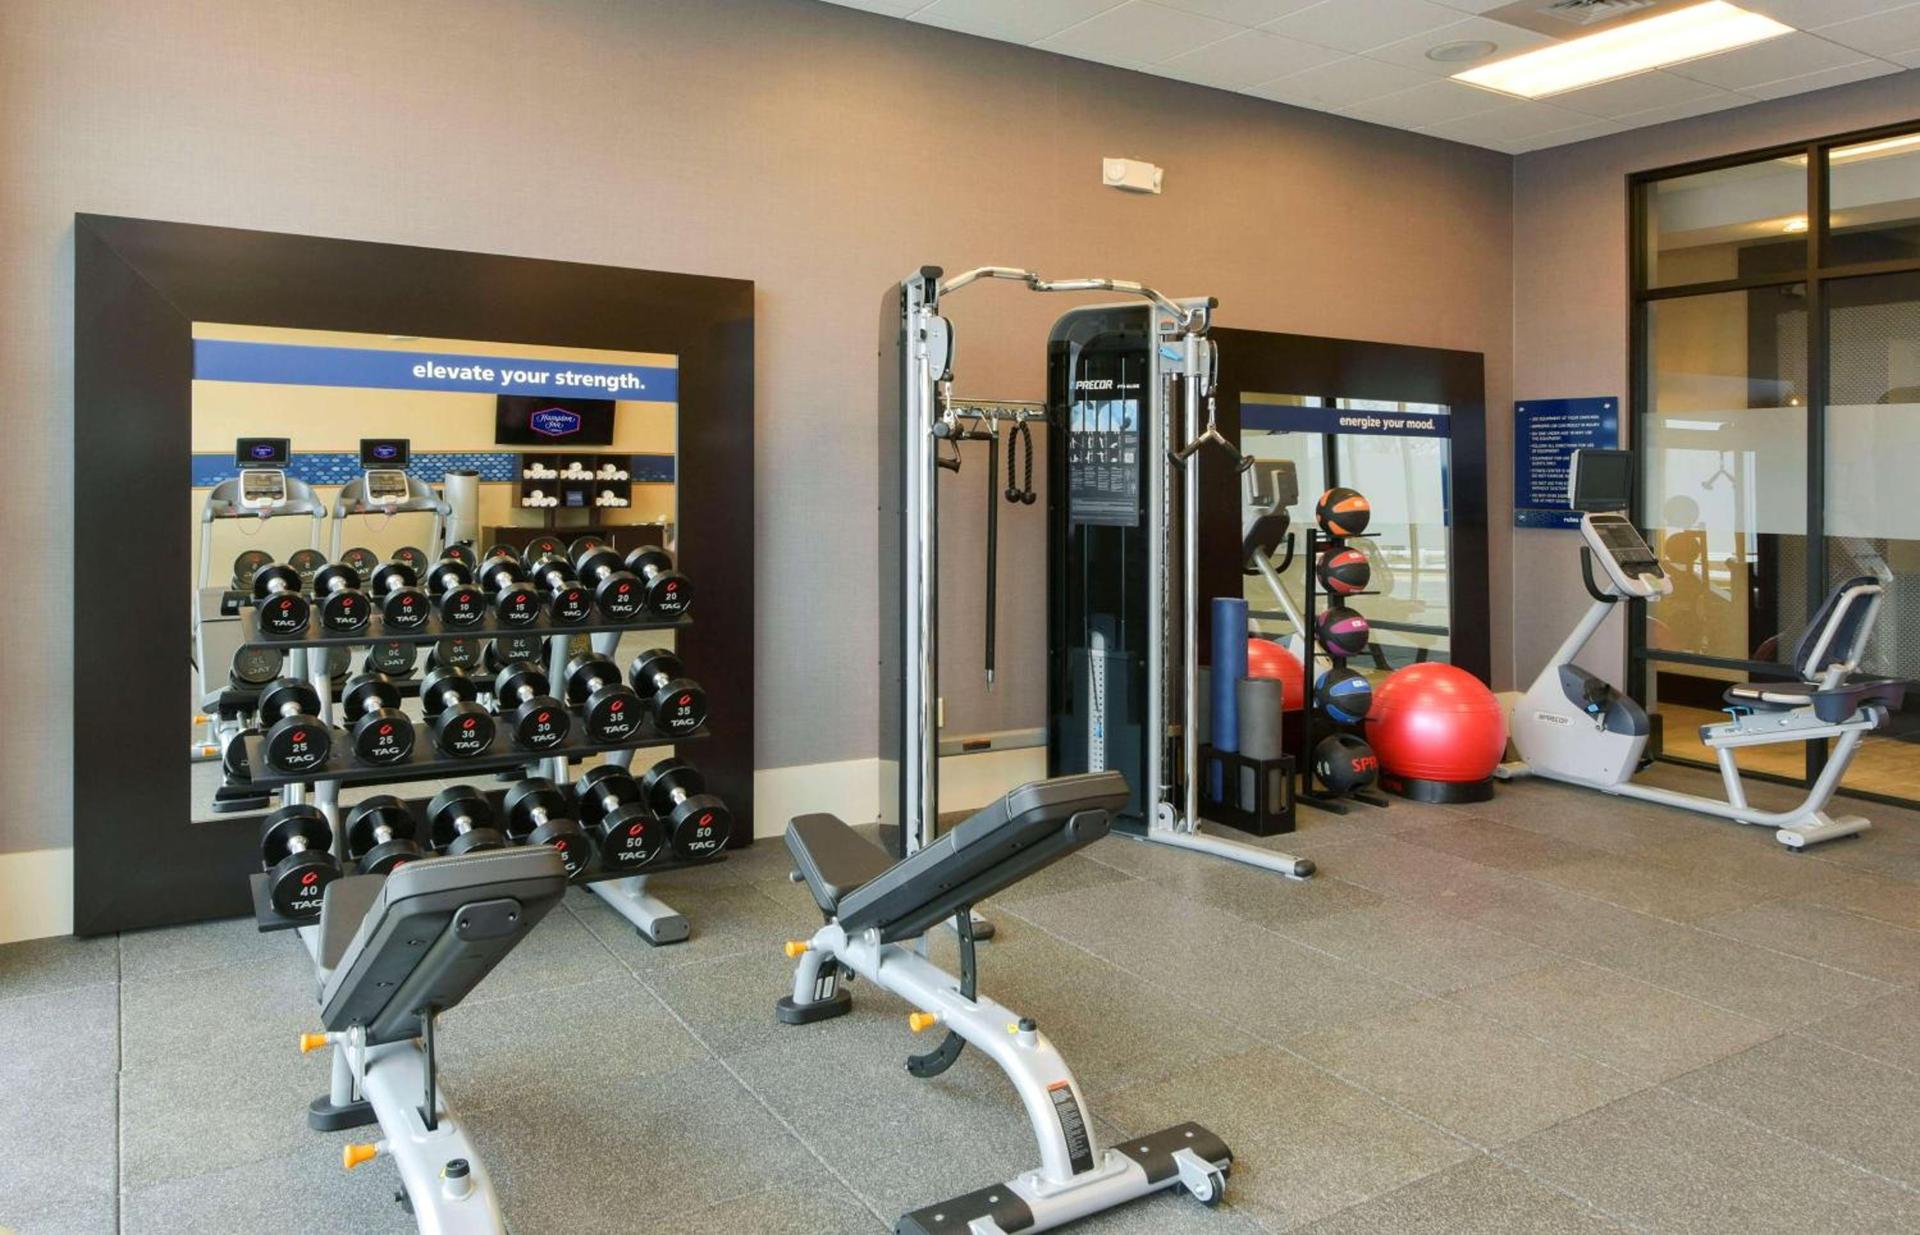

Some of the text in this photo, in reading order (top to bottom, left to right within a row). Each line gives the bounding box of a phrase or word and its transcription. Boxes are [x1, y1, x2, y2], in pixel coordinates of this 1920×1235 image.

[412, 361, 646, 392] elevate your strength.
[1076, 379, 1113, 390] PRECOR
[1340, 416, 1436, 430] energize your mood.
[617, 594, 630, 602] 20
[611, 604, 633, 612] TAG
[335, 616, 357, 624] TAG
[396, 614, 418, 622] TAG
[453, 612, 475, 620] TAG
[509, 612, 530, 620] TAG
[272, 619, 297, 627] TAG
[677, 706, 691, 715] 35
[609, 712, 624, 722] 35
[670, 717, 695, 727] TAG
[537, 723, 550, 732] 30
[603, 723, 630, 733] TAG
[462, 730, 475, 739] 30
[531, 733, 556, 742] TAG
[379, 736, 393, 746] 25
[453, 740, 480, 749] TAG
[292, 743, 308, 753] 25
[371, 746, 400, 756] TAG
[285, 754, 315, 764] TAG
[696, 827, 711, 837] 50
[626, 837, 642, 847] 50
[688, 840, 716, 851] TAG
[618, 851, 647, 861] TAG
[300, 886, 318, 897] 40
